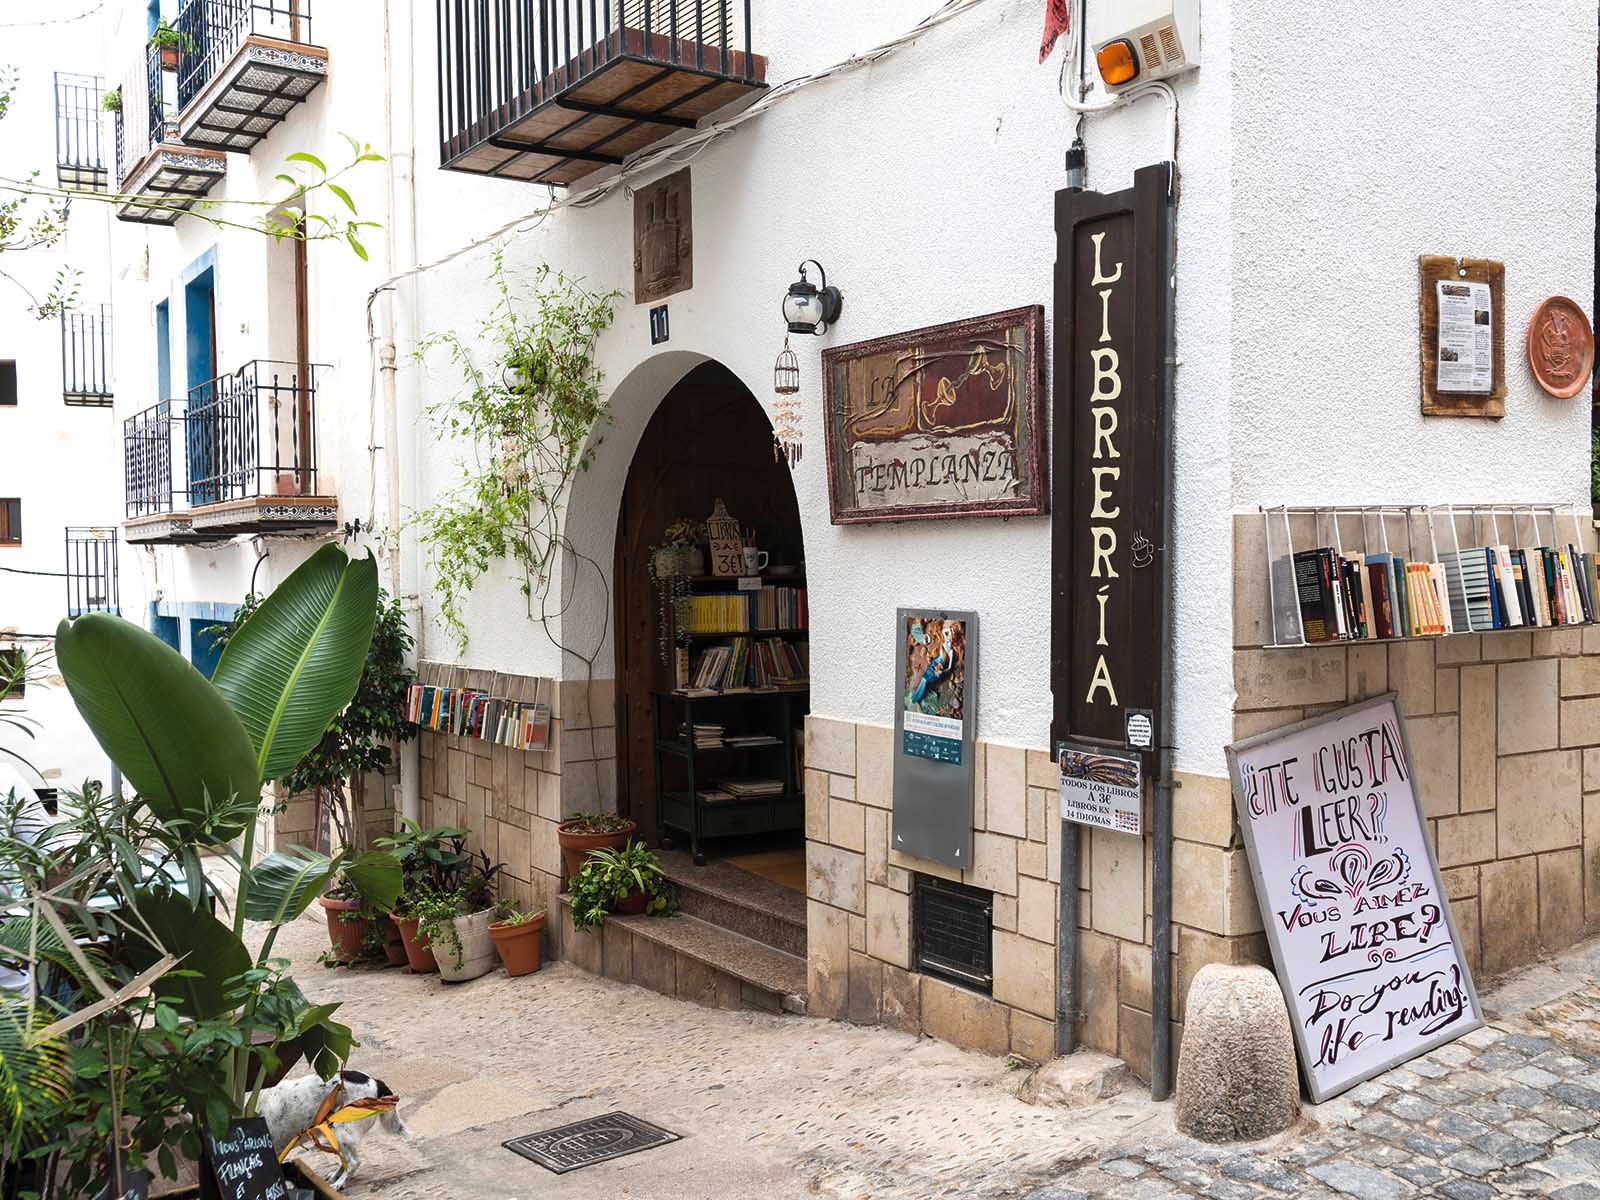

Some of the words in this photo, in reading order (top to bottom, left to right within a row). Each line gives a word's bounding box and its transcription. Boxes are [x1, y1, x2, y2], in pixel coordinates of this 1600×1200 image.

[652, 310, 668, 339] 11
[866, 376, 897, 407] LA
[855, 449, 1018, 494] TEMPLANZA
[1086, 231, 1123, 706] LIBRERÍA
[1318, 722, 1405, 795] GUSTA
[1061, 778, 1088, 790] TODOS
[1090, 783, 1105, 793] LOS
[1107, 786, 1139, 799] LIBROS
[1087, 791, 1096, 802] A
[1098, 793, 1112, 805] 3€
[1067, 799, 1098, 813] LIBROS
[1099, 806, 1110, 815] EN
[1067, 809, 1075, 818] 14
[1076, 811, 1112, 825] IDIOMAS
[1301, 793, 1380, 858] LEER?
[1305, 989, 1364, 1029] Do
[1358, 970, 1446, 1015] you
[1313, 1014, 1380, 1068] like
[236, 1181, 246, 1199] ET
